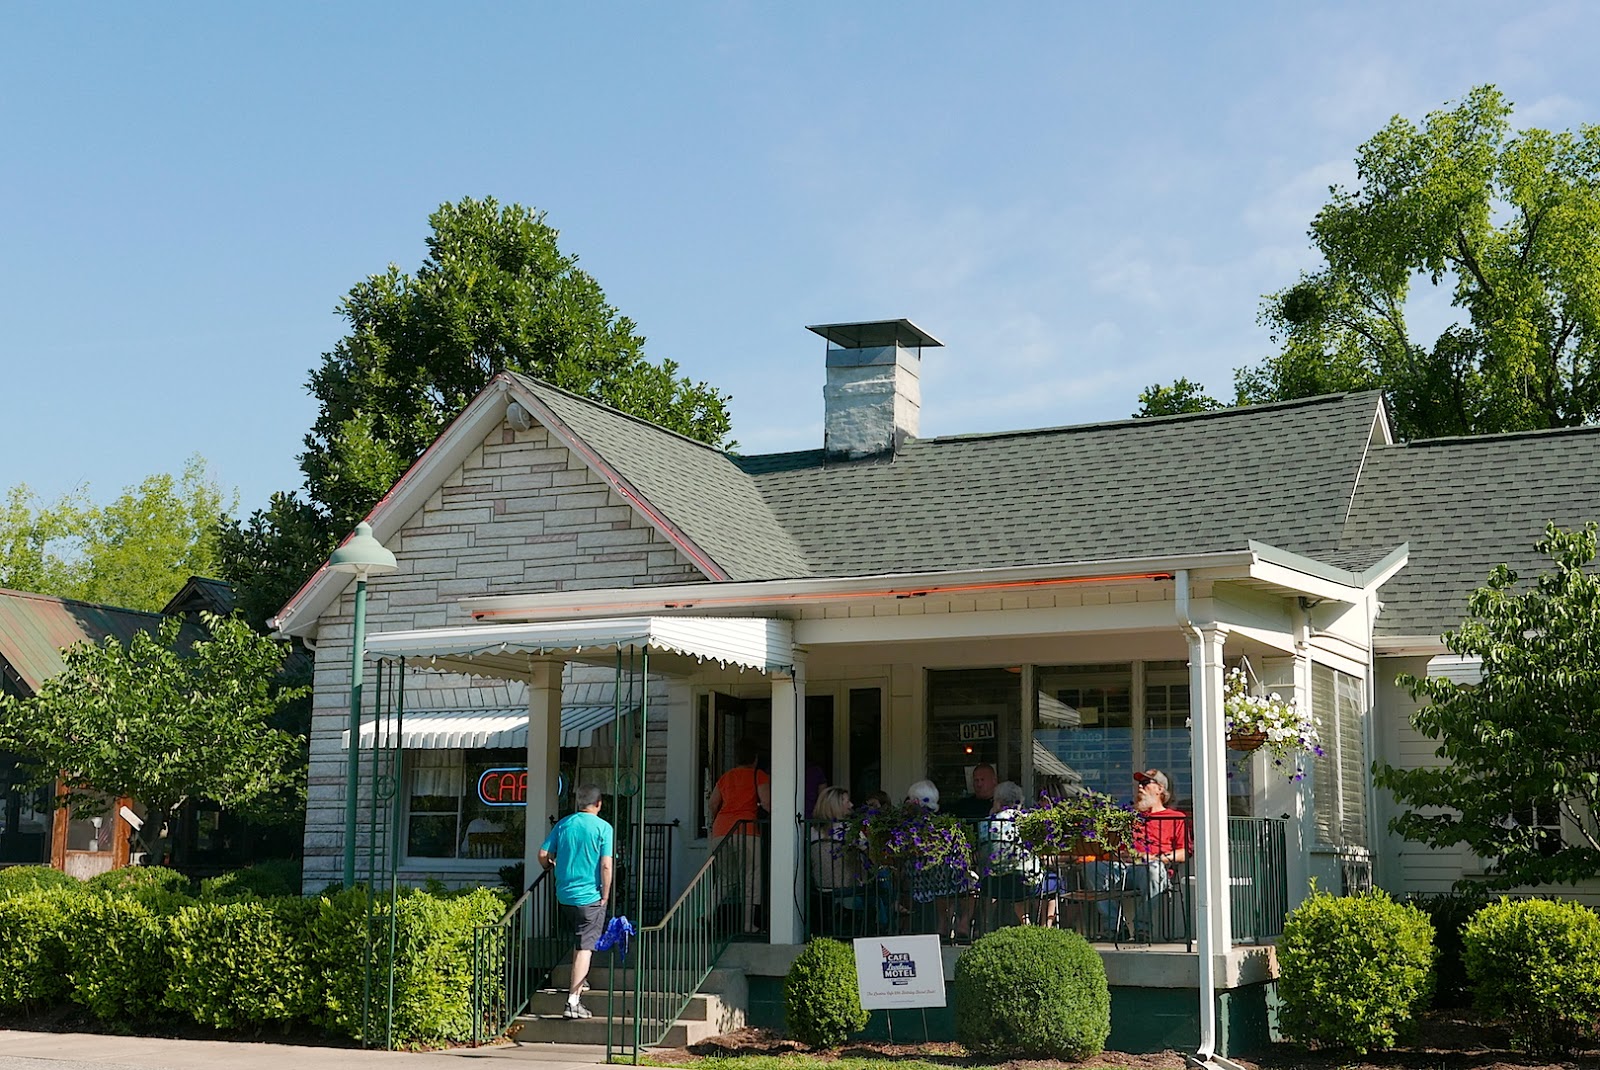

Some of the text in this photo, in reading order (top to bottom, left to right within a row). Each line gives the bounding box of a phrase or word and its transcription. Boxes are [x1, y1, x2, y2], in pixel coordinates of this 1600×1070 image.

[963, 723, 993, 738] OPEN
[482, 773, 529, 801] CAF
[885, 970, 915, 978] MOTEL
